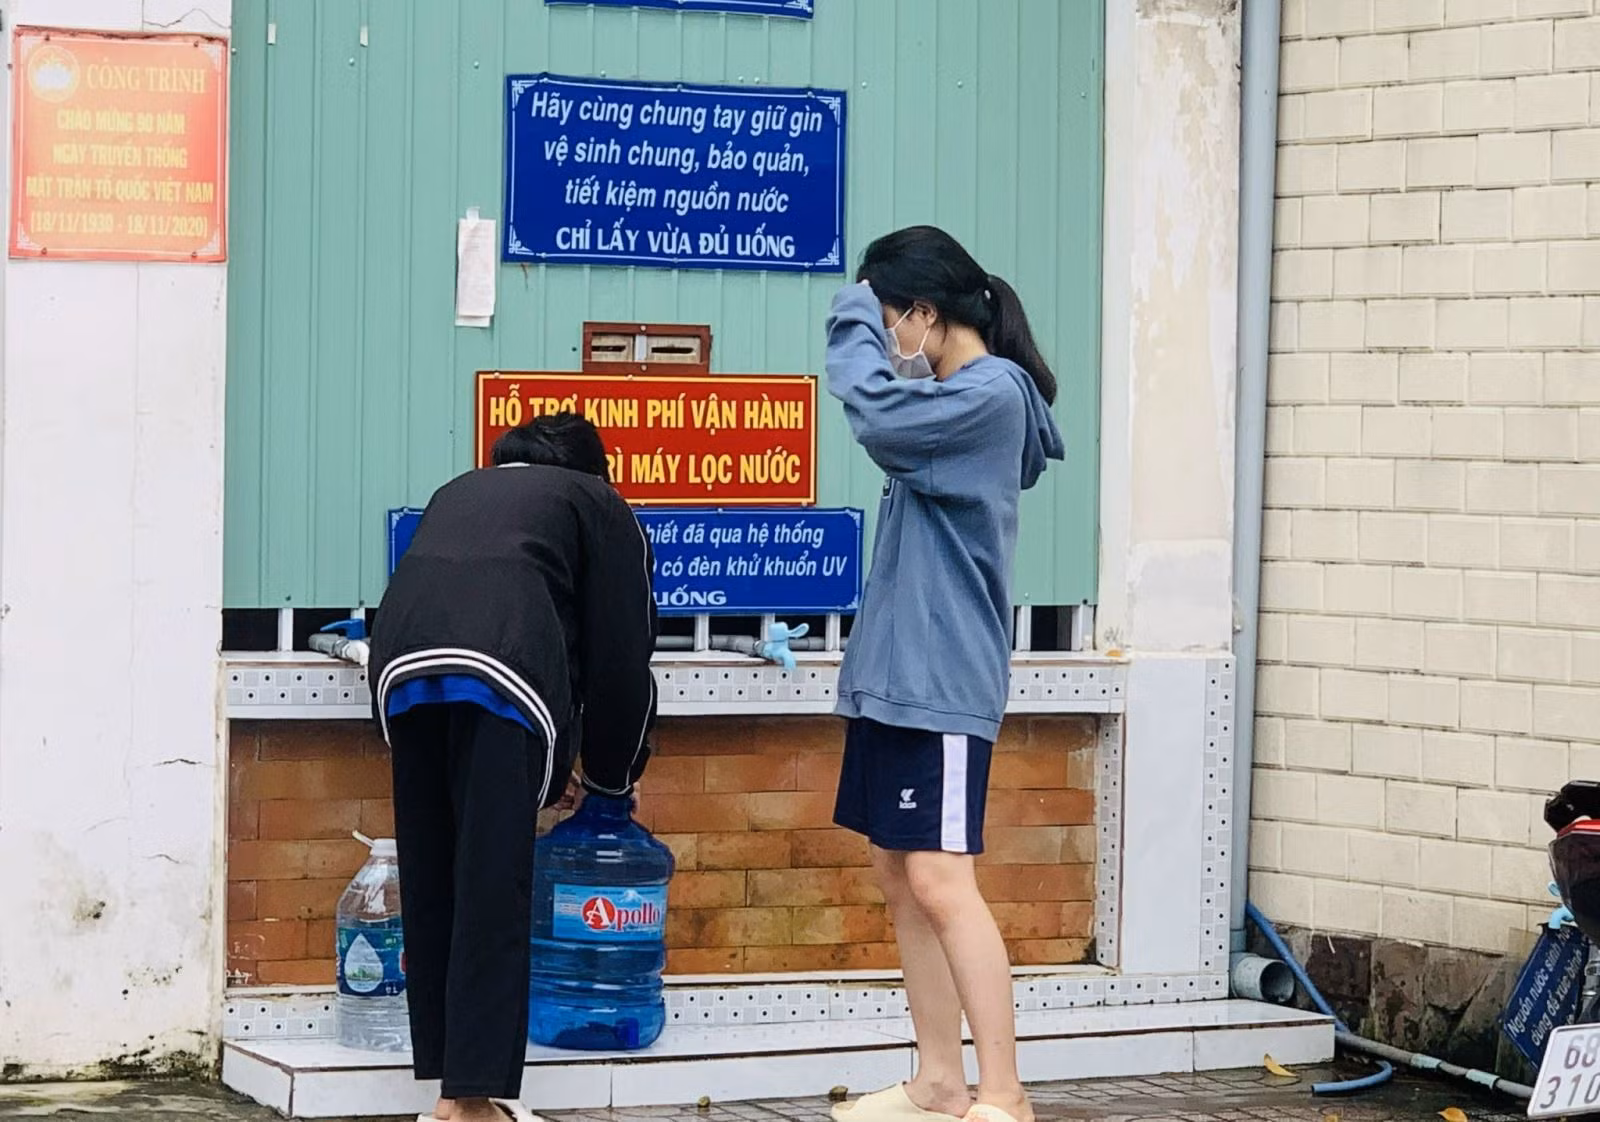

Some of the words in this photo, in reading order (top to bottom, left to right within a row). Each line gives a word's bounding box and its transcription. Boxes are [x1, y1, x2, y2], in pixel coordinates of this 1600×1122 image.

[87, 57, 140, 91] CÔNG
[145, 60, 206, 93] TRÌNH
[57, 106, 92, 130] CHÀO
[137, 111, 153, 132] 90
[531, 91, 574, 125] Hãy
[579, 95, 634, 130] cùng
[639, 100, 707, 134] chung
[713, 104, 746, 136] tay
[750, 104, 788, 137] giữ
[789, 105, 823, 138] gìn
[544, 135, 569, 167] vệ
[574, 137, 622, 164] sinh
[627, 140, 700, 175] chung,
[707, 141, 748, 170] bảo
[752, 143, 809, 177] quản,
[186, 182, 214, 203] NAM
[565, 175, 600, 205] tiết
[605, 180, 657, 212] kiệm
[663, 180, 731, 216] nguồn
[736, 187, 790, 213] nước
[555, 219, 592, 250] CHỈ
[597, 217, 640, 252] LẤY
[647, 222, 692, 255] VỪA
[698, 224, 730, 256] ĐỦ
[736, 222, 796, 258] UỐNG
[489, 383, 523, 427] HỖ
[584, 398, 639, 428] KINH
[646, 393, 687, 428] PHÍ
[690, 392, 737, 436] VẬN
[744, 393, 804, 430] HÀNH
[604, 446, 624, 483] RÌ
[631, 447, 681, 484] MÁY
[688, 454, 733, 491] LỌC
[740, 446, 801, 484] NƯỚC
[646, 519, 679, 544] hiết
[683, 523, 705, 544] đã
[709, 527, 742, 549] qua
[747, 523, 769, 548] hệ
[773, 520, 825, 549] thống
[661, 555, 683, 577] có
[687, 555, 722, 577] đèn
[726, 553, 761, 577] khử
[822, 556, 848, 577] UV
[585, 896, 661, 932] Apollo
